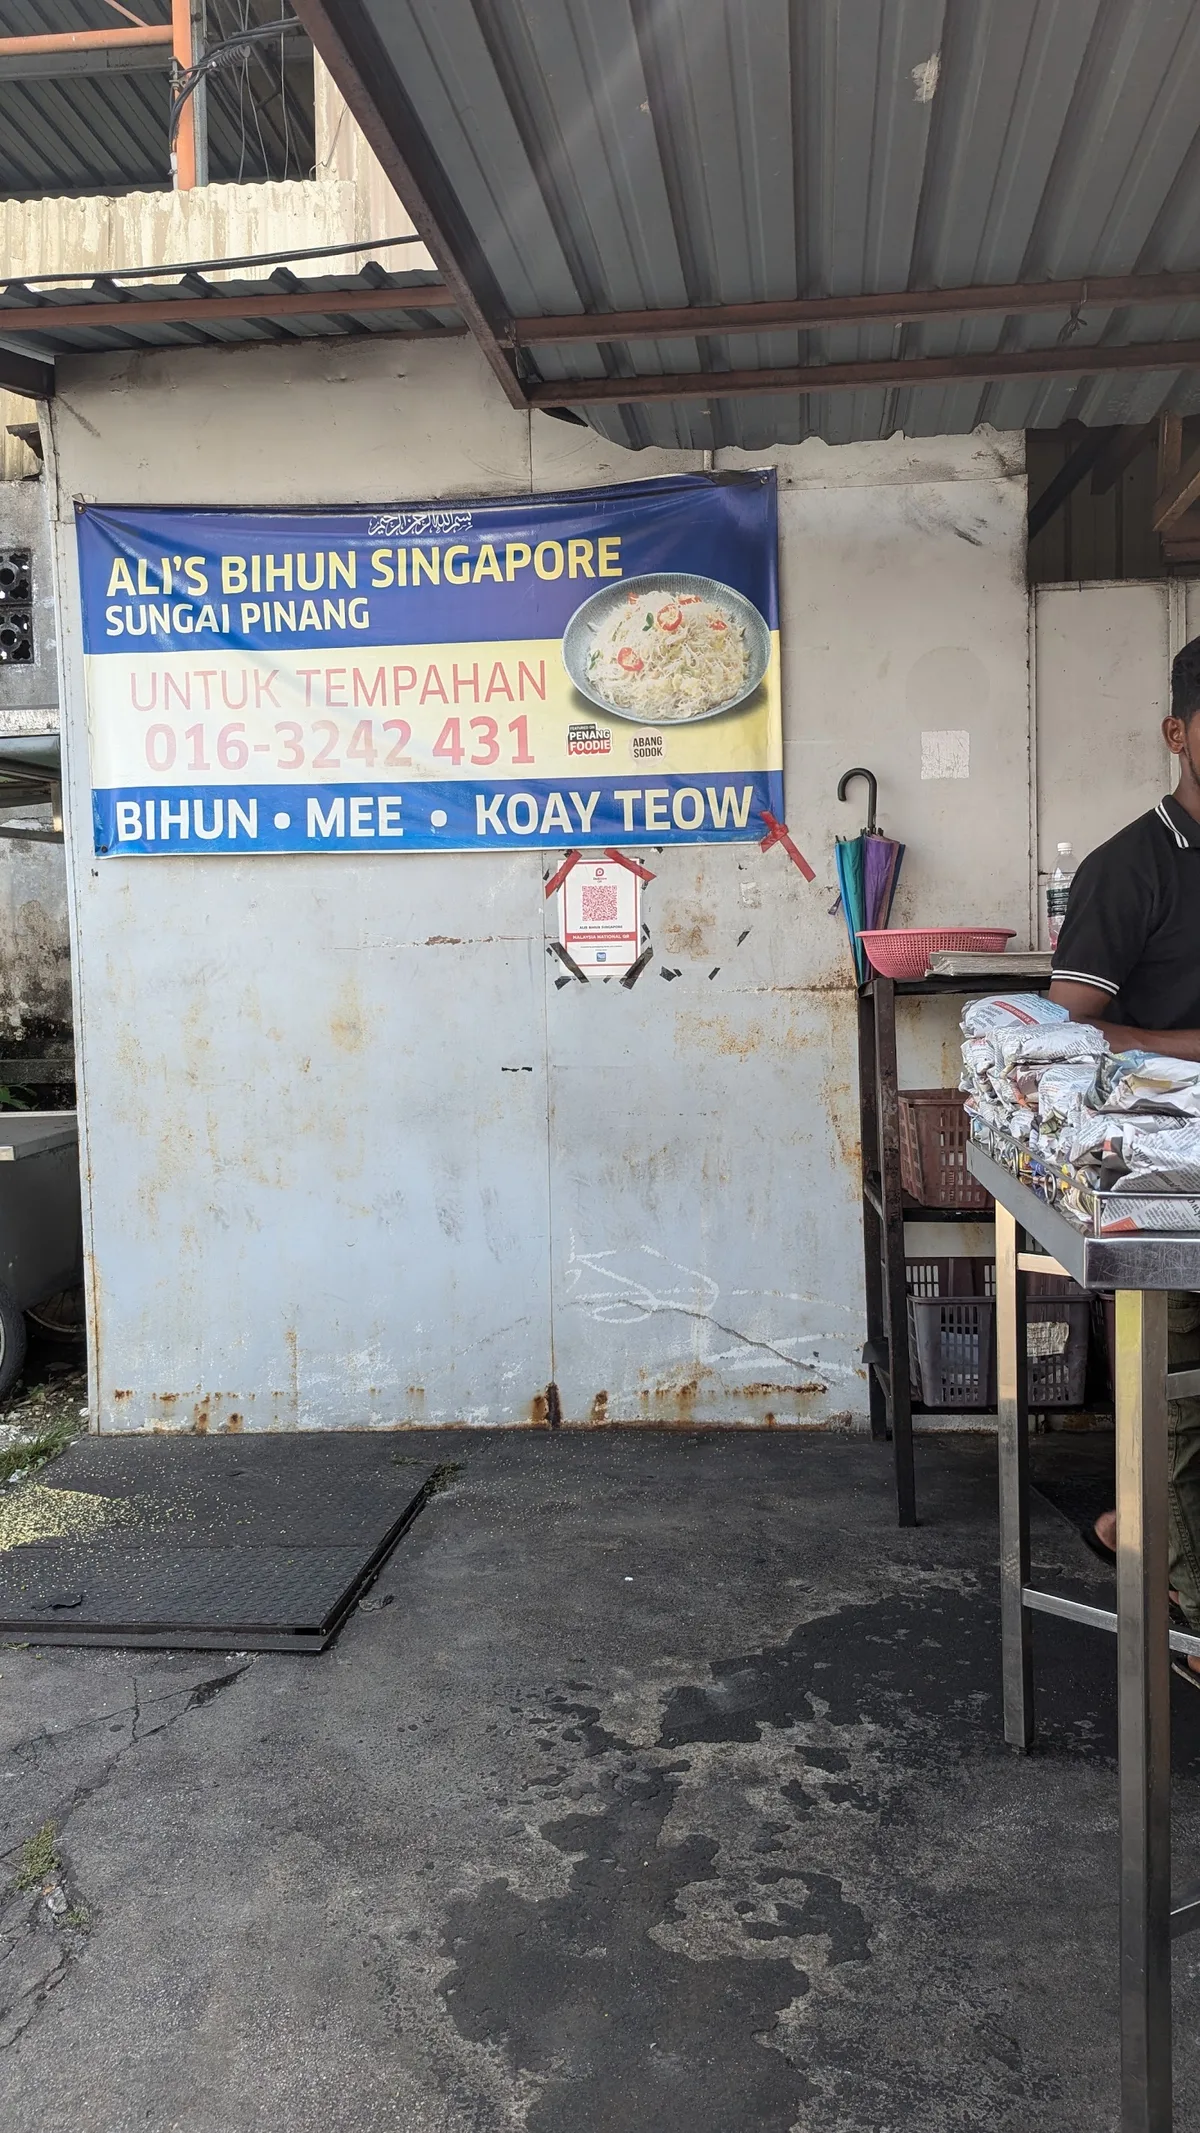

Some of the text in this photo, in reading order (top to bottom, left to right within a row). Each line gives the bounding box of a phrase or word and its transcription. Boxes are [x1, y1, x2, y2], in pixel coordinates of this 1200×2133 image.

[106, 536, 623, 596] ALI'S BIHUN SINGAPORE
[105, 597, 370, 636] SUNGAI PINANG
[130, 660, 547, 712] UNTUK TEMPAHAN
[144, 714, 535, 772] 016-3242 431
[569, 730, 610, 740] PENANG
[569, 740, 611, 751] FOODIE
[633, 736, 663, 748] ABANG
[633, 747, 663, 758] SODOK
[115, 785, 754, 841] BIHUN MEE KOAY TEOW
